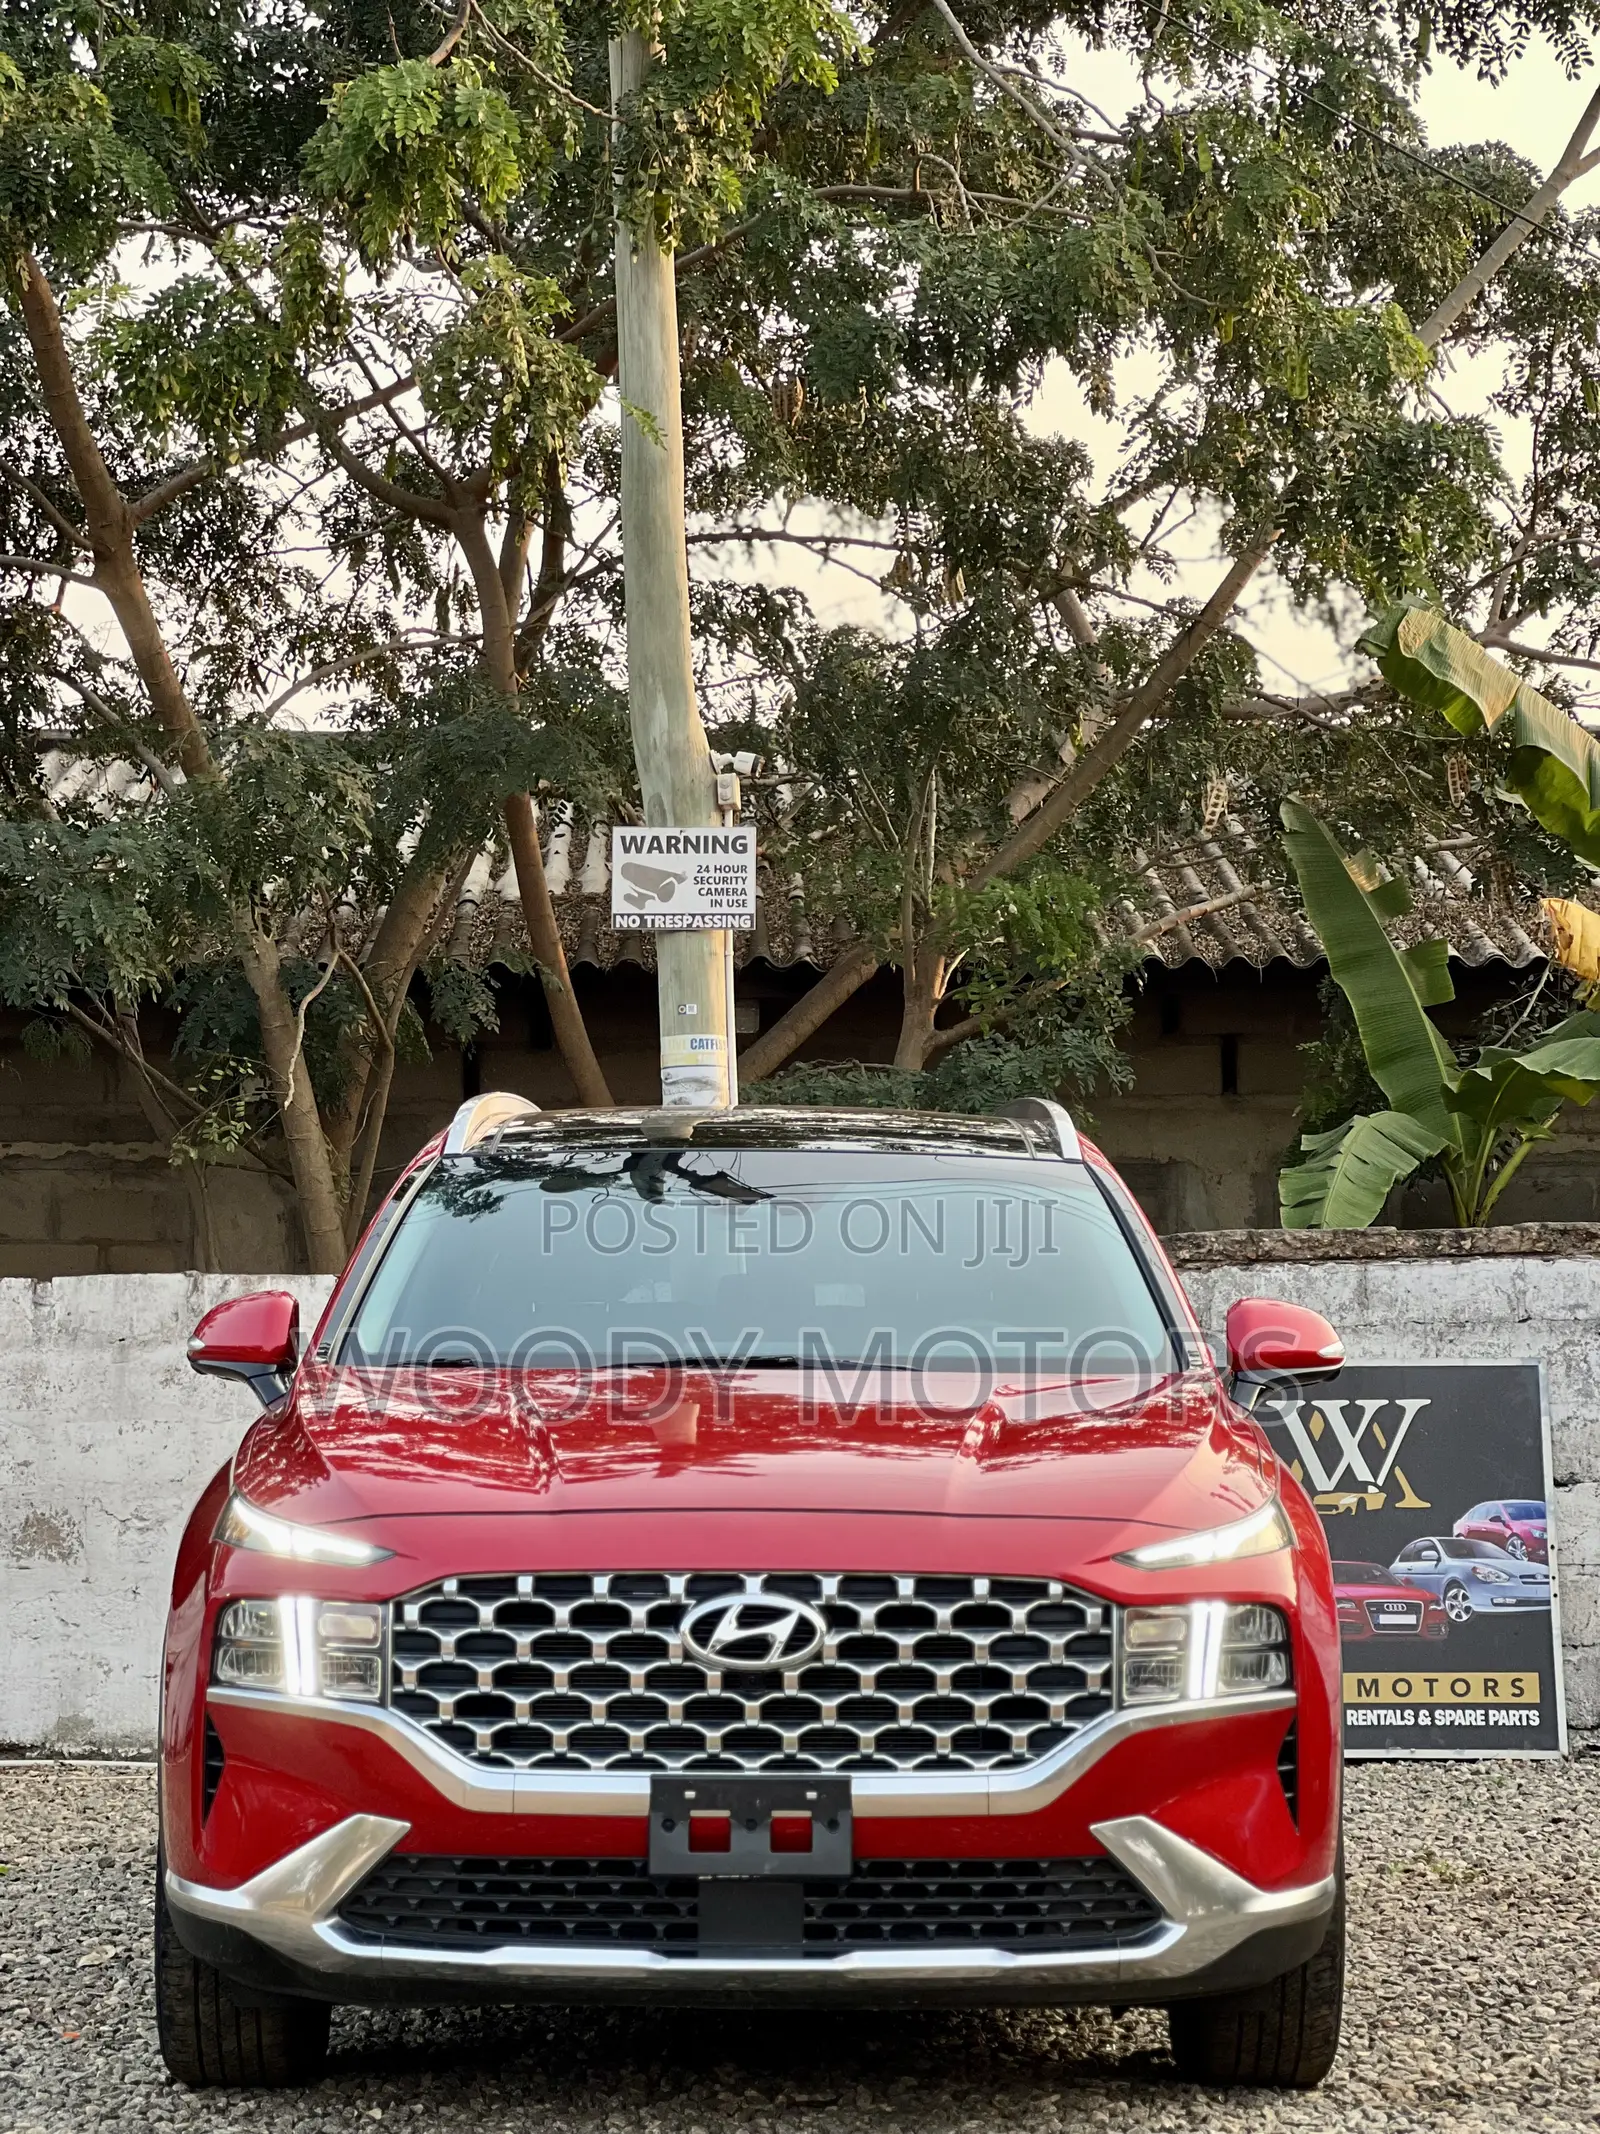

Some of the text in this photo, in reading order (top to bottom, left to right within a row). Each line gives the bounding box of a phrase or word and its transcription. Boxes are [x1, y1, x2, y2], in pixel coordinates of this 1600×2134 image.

[620, 835, 748, 854] WARNING
[697, 865, 748, 874] 24 HOUR
[693, 876, 748, 885] SECURITY
[698, 887, 748, 897] CAMERA
[710, 899, 748, 908] IN USE
[615, 915, 752, 929] NO TRESPASSING
[1356, 1677, 1526, 1699] MOTORS
[1346, 1709, 1541, 1726] RENTALS & SPARE PARTS
